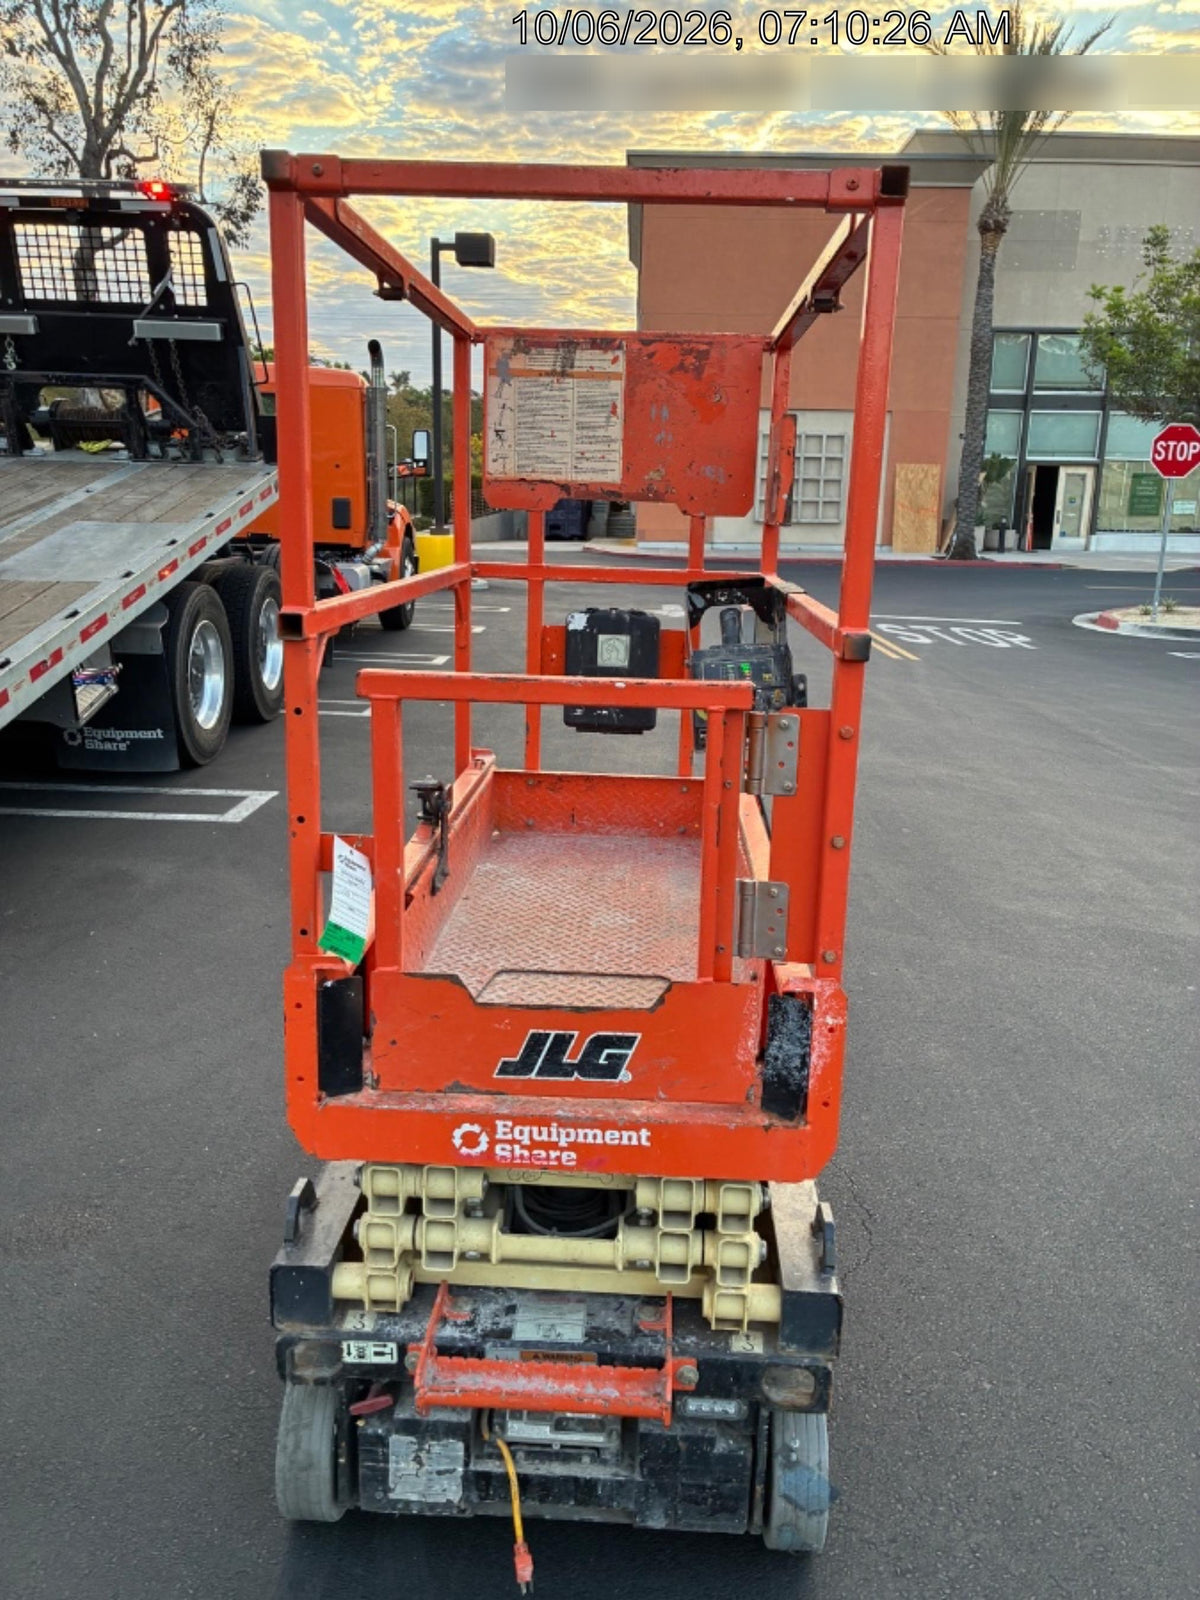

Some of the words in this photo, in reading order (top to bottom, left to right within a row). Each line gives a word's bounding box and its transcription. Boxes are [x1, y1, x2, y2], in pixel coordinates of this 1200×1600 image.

[1154, 440, 1200, 461] STOP
[875, 623, 1040, 650] STOP
[83, 727, 164, 740] Equipment
[84, 739, 128, 751] Share
[493, 1029, 642, 1082] JLG
[494, 1120, 651, 1147] Equipment
[494, 1143, 577, 1166] Share
